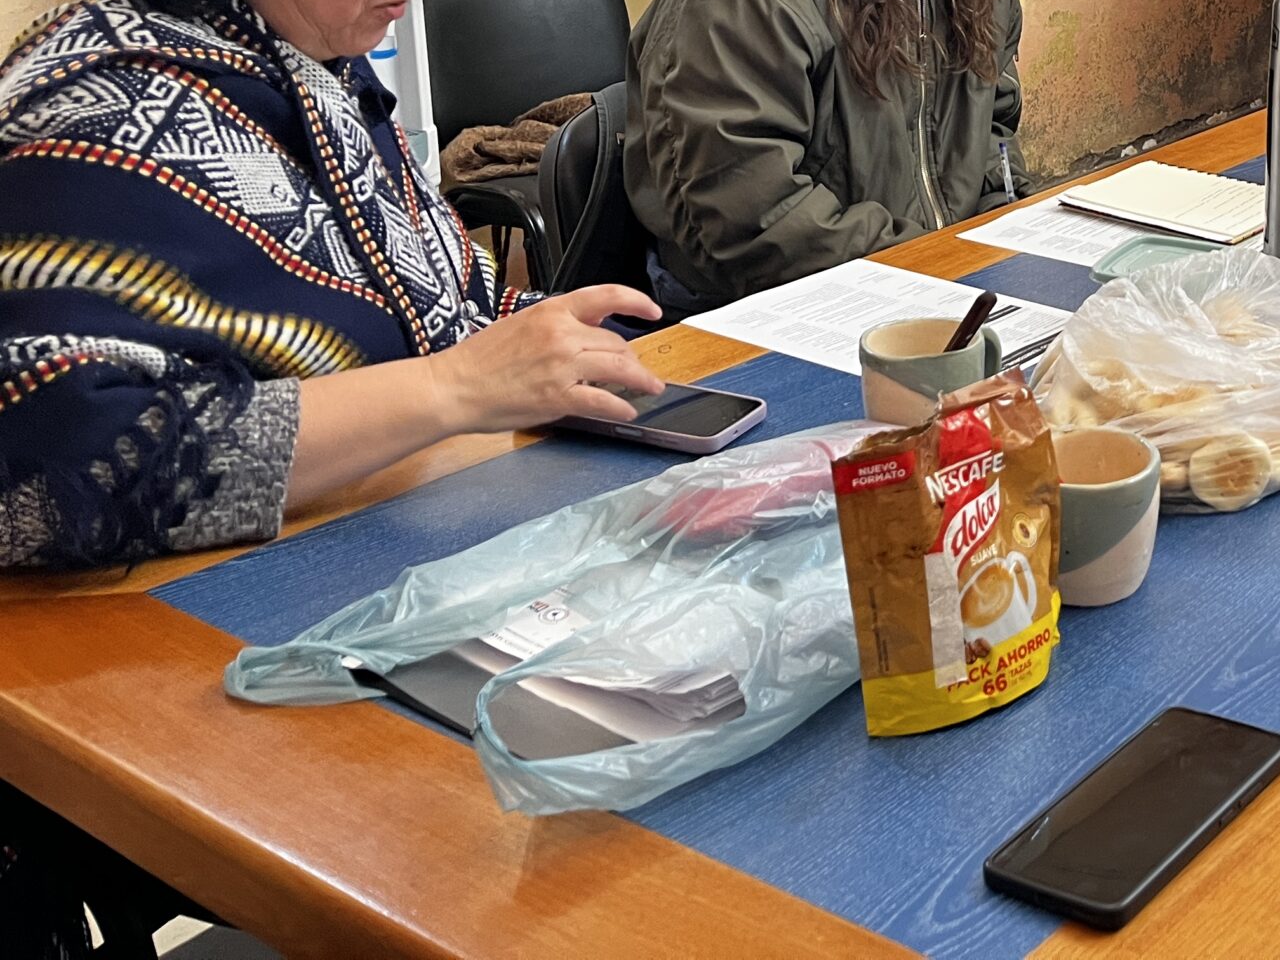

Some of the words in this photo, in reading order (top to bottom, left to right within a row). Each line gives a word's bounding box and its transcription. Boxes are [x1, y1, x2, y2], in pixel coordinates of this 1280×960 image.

[852, 469, 906, 488] FORMATO
[858, 461, 897, 475] NUEVO
[970, 544, 998, 567] SUAVE
[996, 628, 1050, 672] AHORRO
[983, 673, 1007, 696] 66
[1009, 659, 1033, 677] TAZAS
